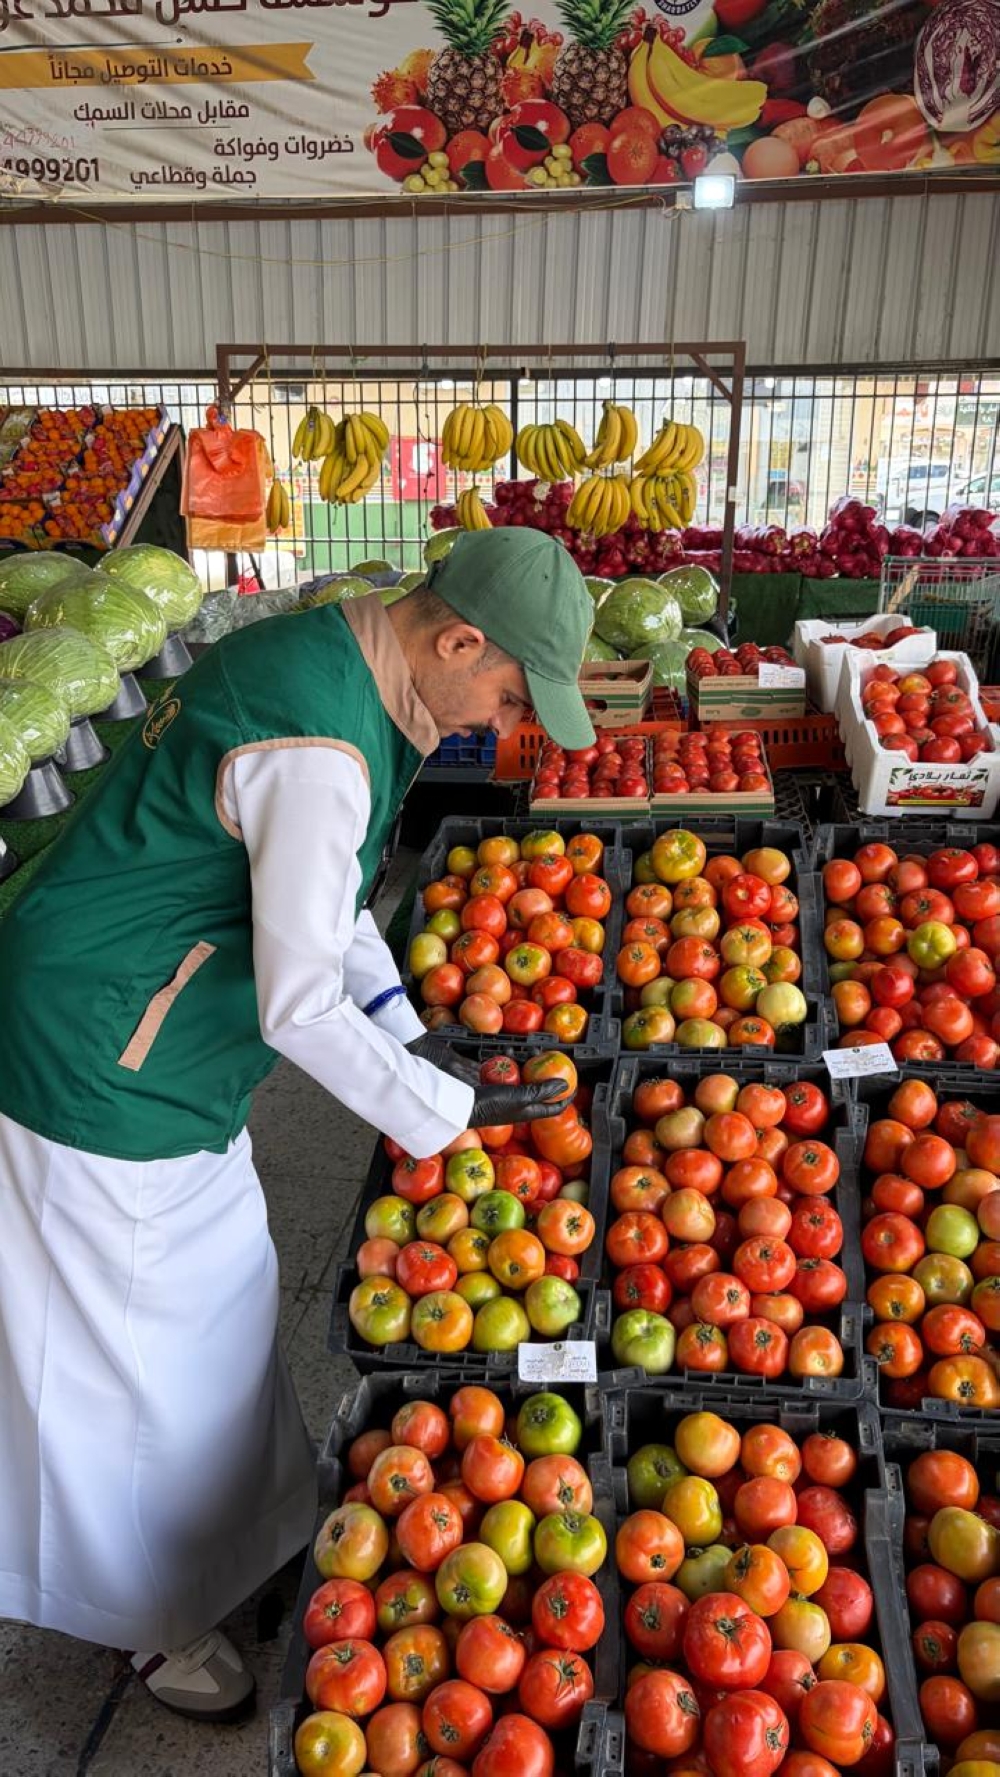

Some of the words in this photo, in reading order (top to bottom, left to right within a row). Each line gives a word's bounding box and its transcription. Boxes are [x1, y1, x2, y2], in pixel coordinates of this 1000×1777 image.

[101, 58, 170, 84] التوصيل
[173, 56, 233, 77] خدمات
[140, 100, 193, 120] محلات
[197, 99, 251, 125] مقابل
[213, 136, 280, 162] وفواكة
[284, 134, 355, 161] خضروات
[129, 165, 207, 190] وقطاعي
[211, 163, 257, 189] جملة
